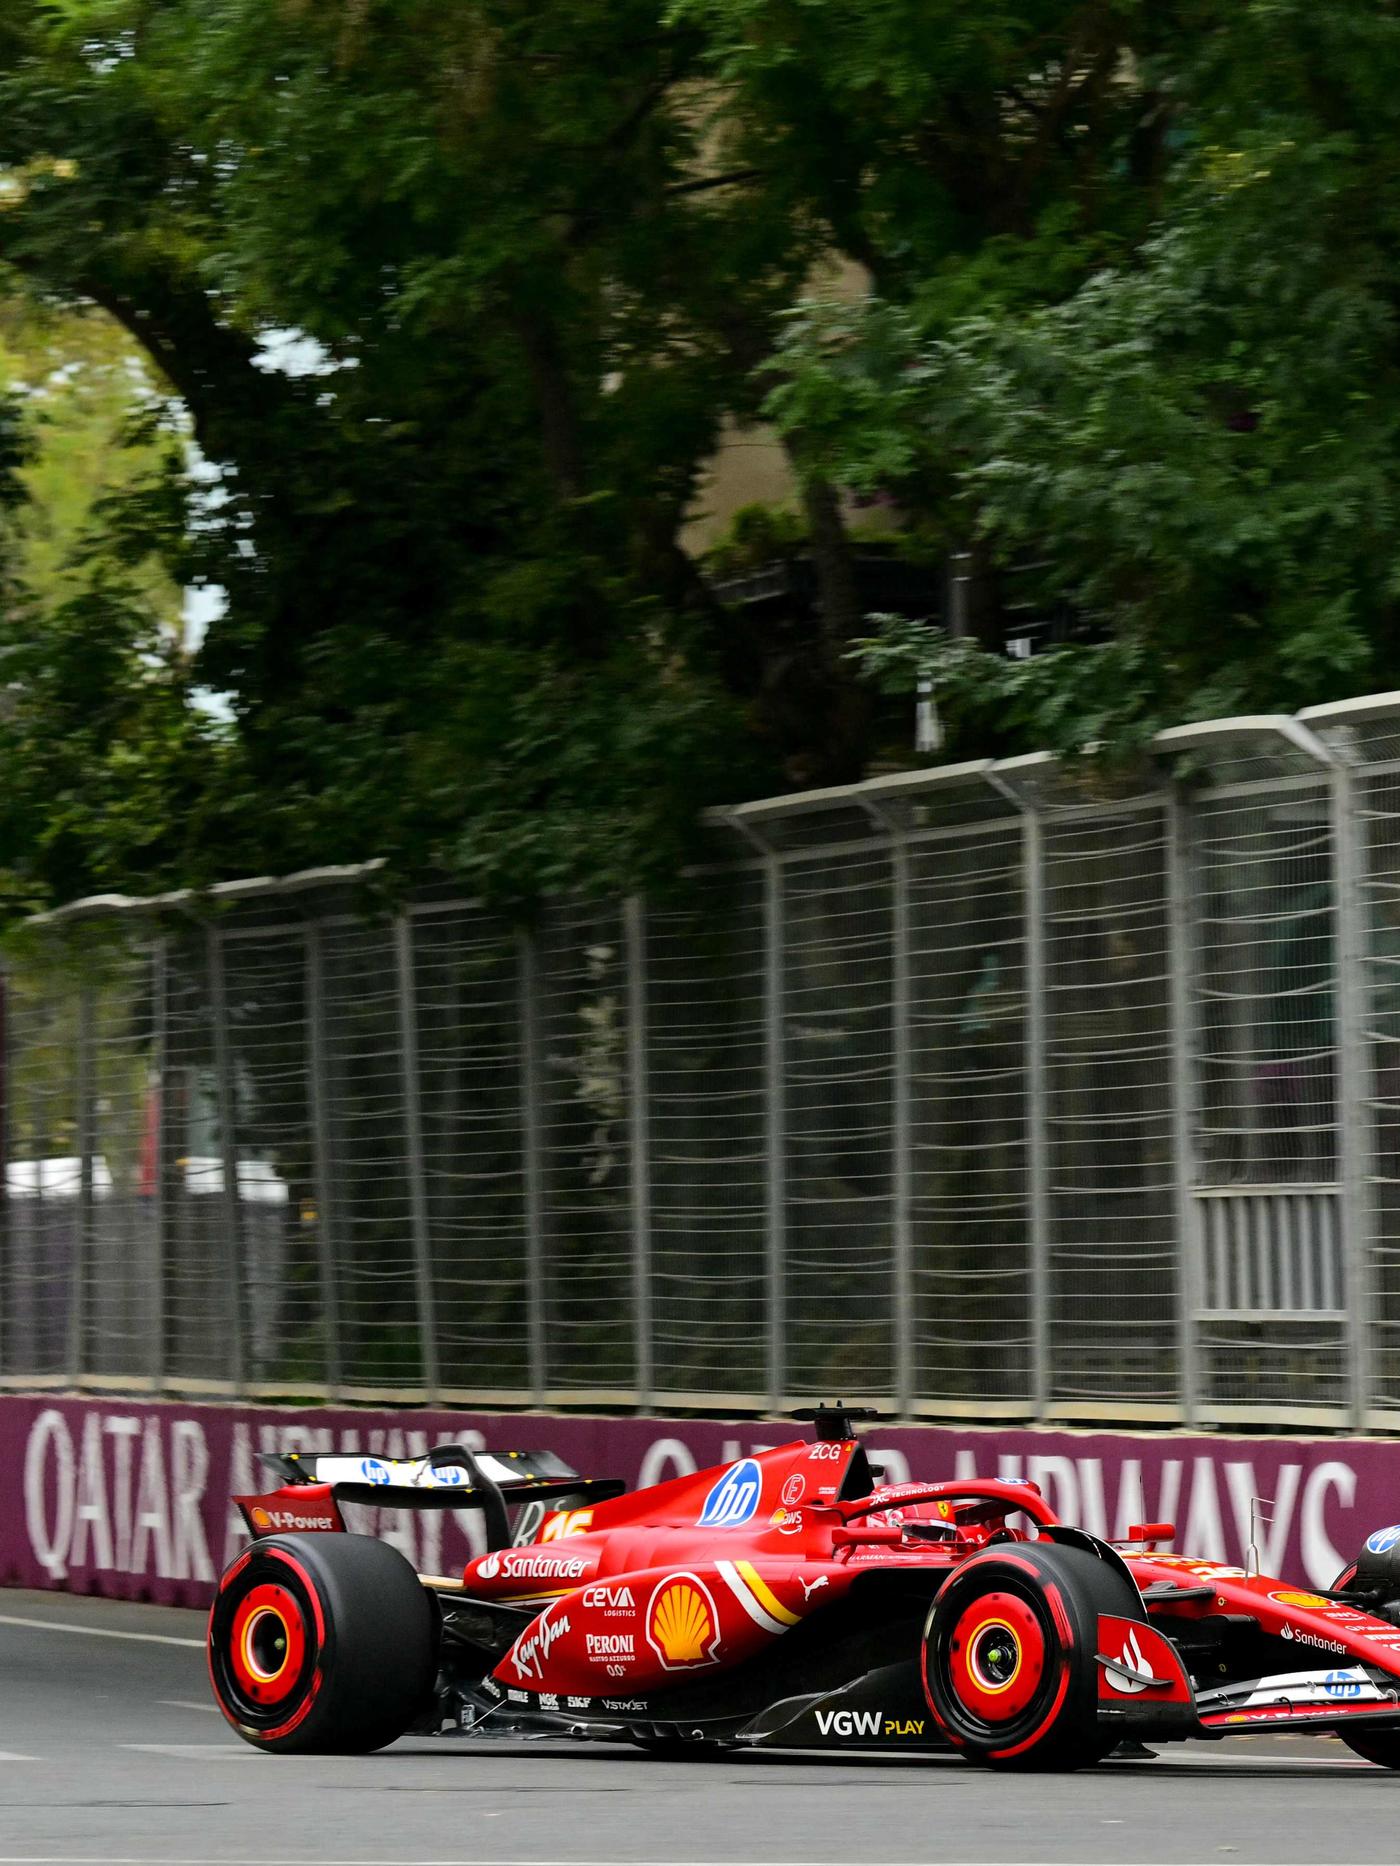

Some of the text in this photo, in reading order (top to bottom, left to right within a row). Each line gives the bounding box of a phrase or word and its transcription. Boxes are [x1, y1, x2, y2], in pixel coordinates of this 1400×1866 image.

[808, 1444, 841, 1460] ZCG
[24, 1409, 216, 1583] QATAR
[699, 1459, 761, 1526] hp
[892, 1485, 945, 1498] TECHNOLOGY
[270, 1513, 333, 1529] V-Power
[501, 1554, 592, 1578] Santander
[604, 1609, 636, 1617] LOGISTICS
[586, 1634, 634, 1654] PERONI
[1295, 1628, 1347, 1655] Santander
[539, 1693, 559, 1706] NGK
[567, 1696, 591, 1708] SKF
[1251, 1709, 1348, 1720] V-Power
[815, 1711, 924, 1735] VGW PLAY
